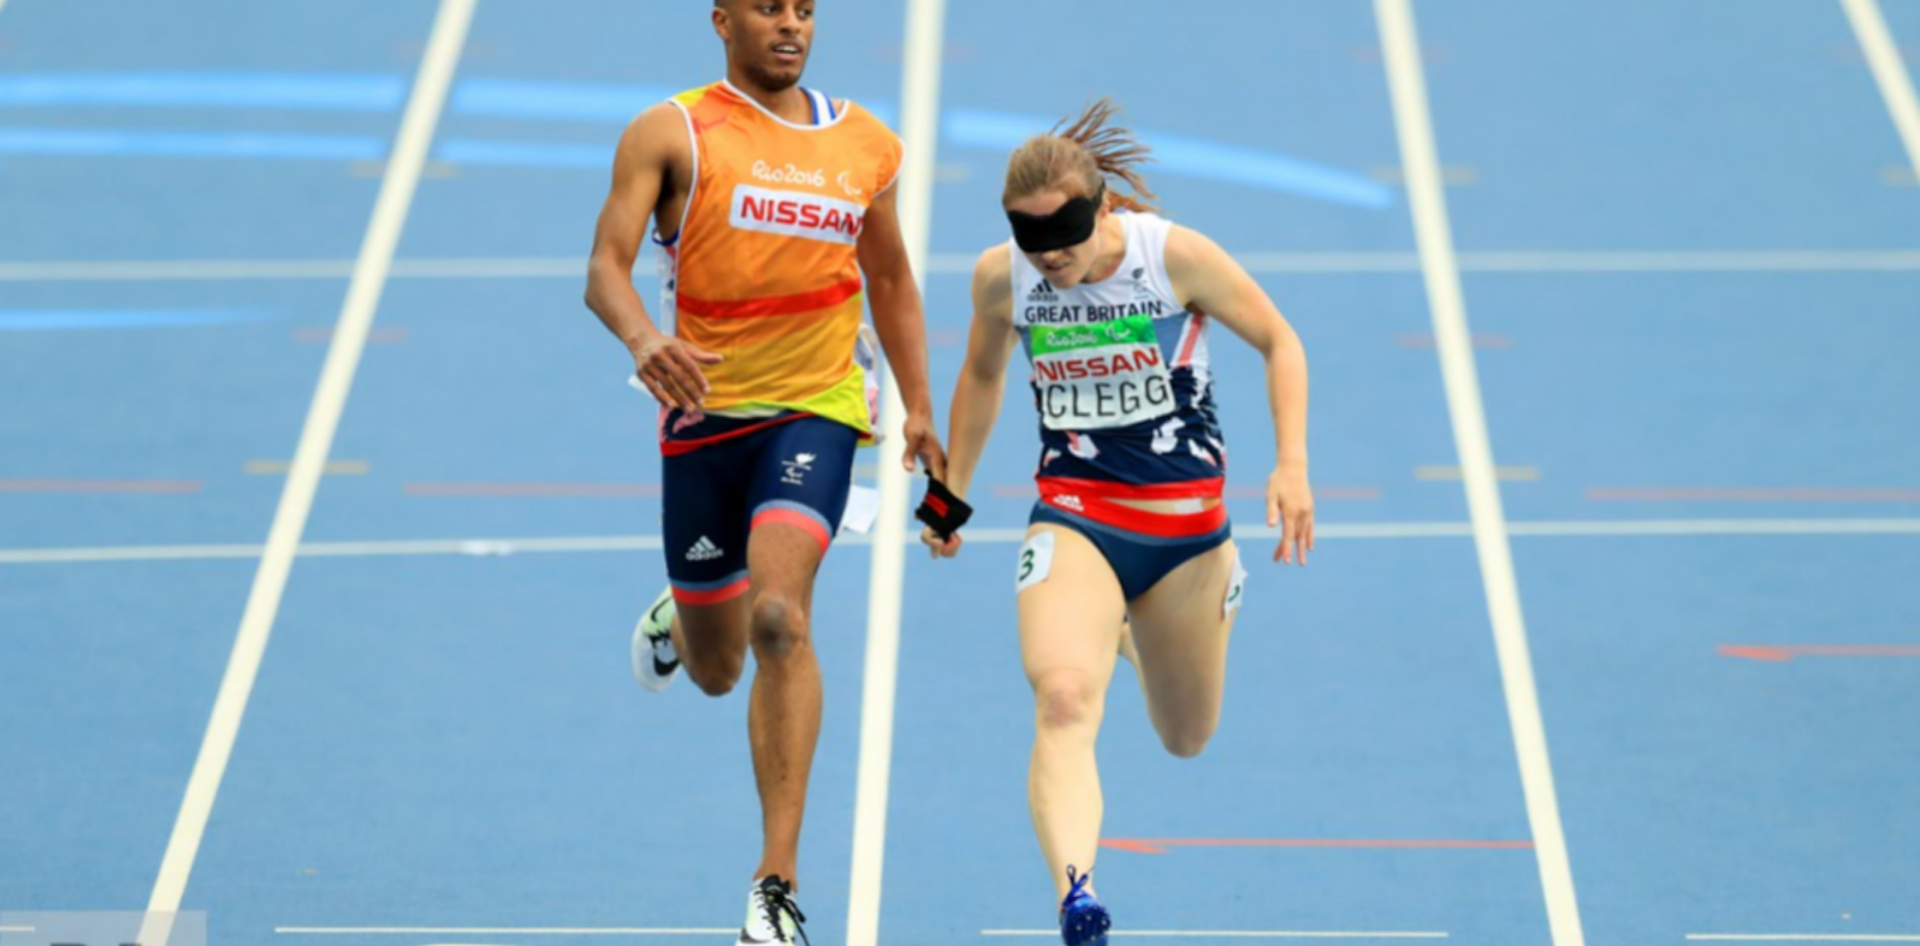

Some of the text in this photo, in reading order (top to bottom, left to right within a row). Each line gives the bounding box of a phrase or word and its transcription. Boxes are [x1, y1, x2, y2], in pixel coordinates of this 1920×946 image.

[741, 196, 862, 236] NISSAN
[1024, 300, 1163, 323] GREAT BRITAIN
[1035, 347, 1160, 382] NISSAN
[1046, 375, 1169, 418] CLEGG
[1019, 548, 1035, 582] 3
